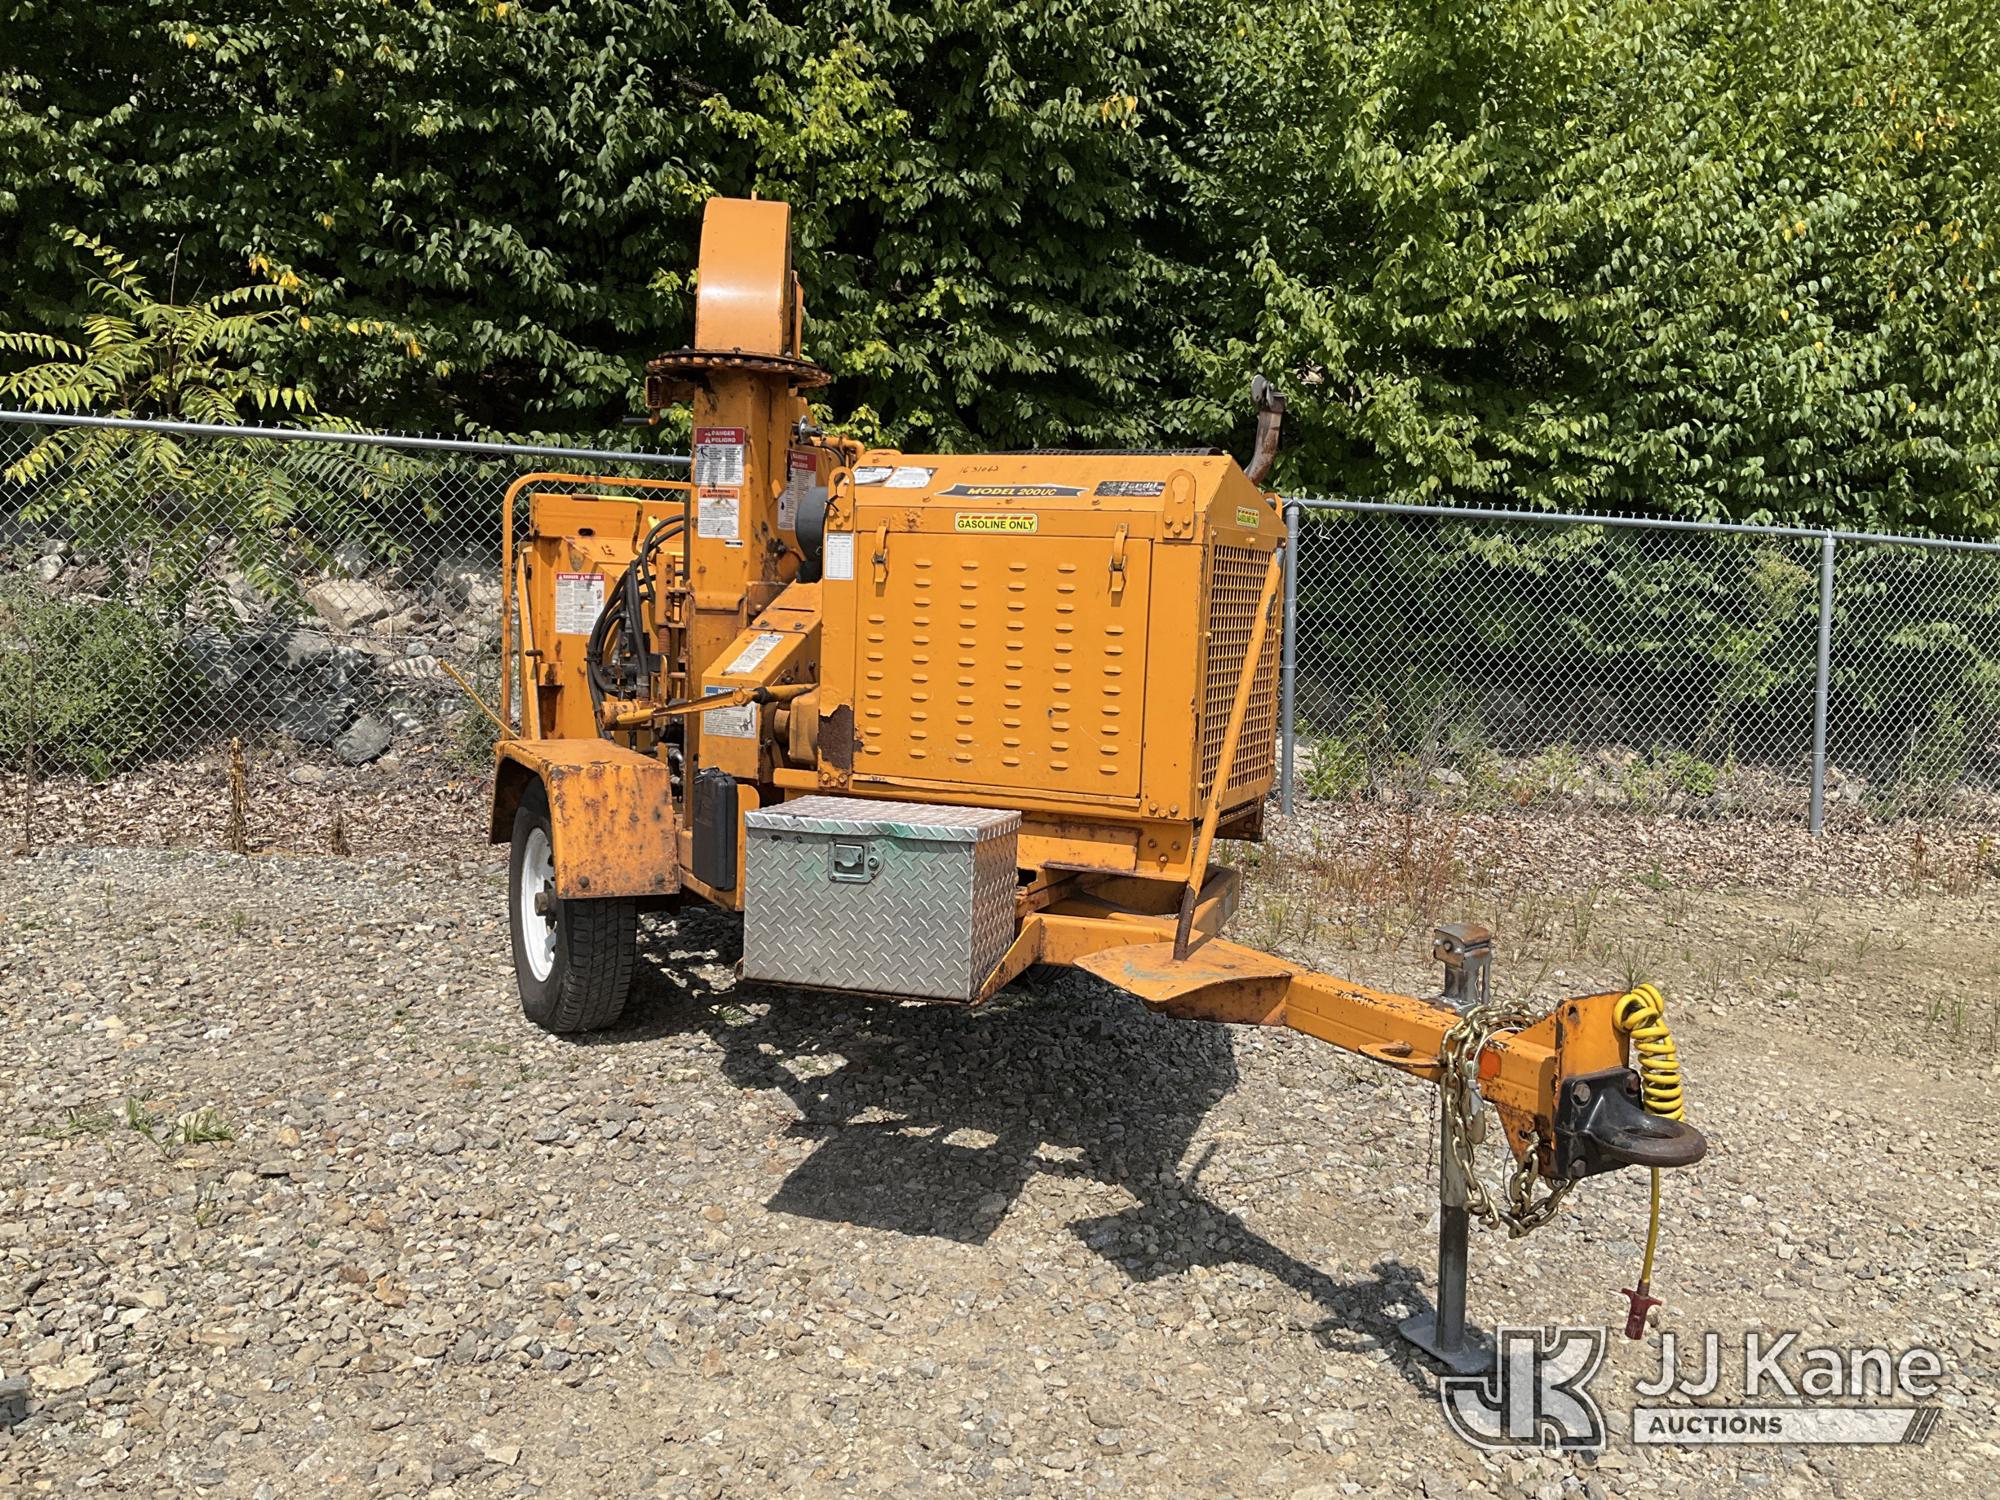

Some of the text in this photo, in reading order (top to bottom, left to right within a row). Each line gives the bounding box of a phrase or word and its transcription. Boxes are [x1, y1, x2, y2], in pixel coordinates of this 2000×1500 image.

[966, 487, 1057, 496] MODEL 200UC
[957, 519, 1035, 530] GASOLINE ONLY
